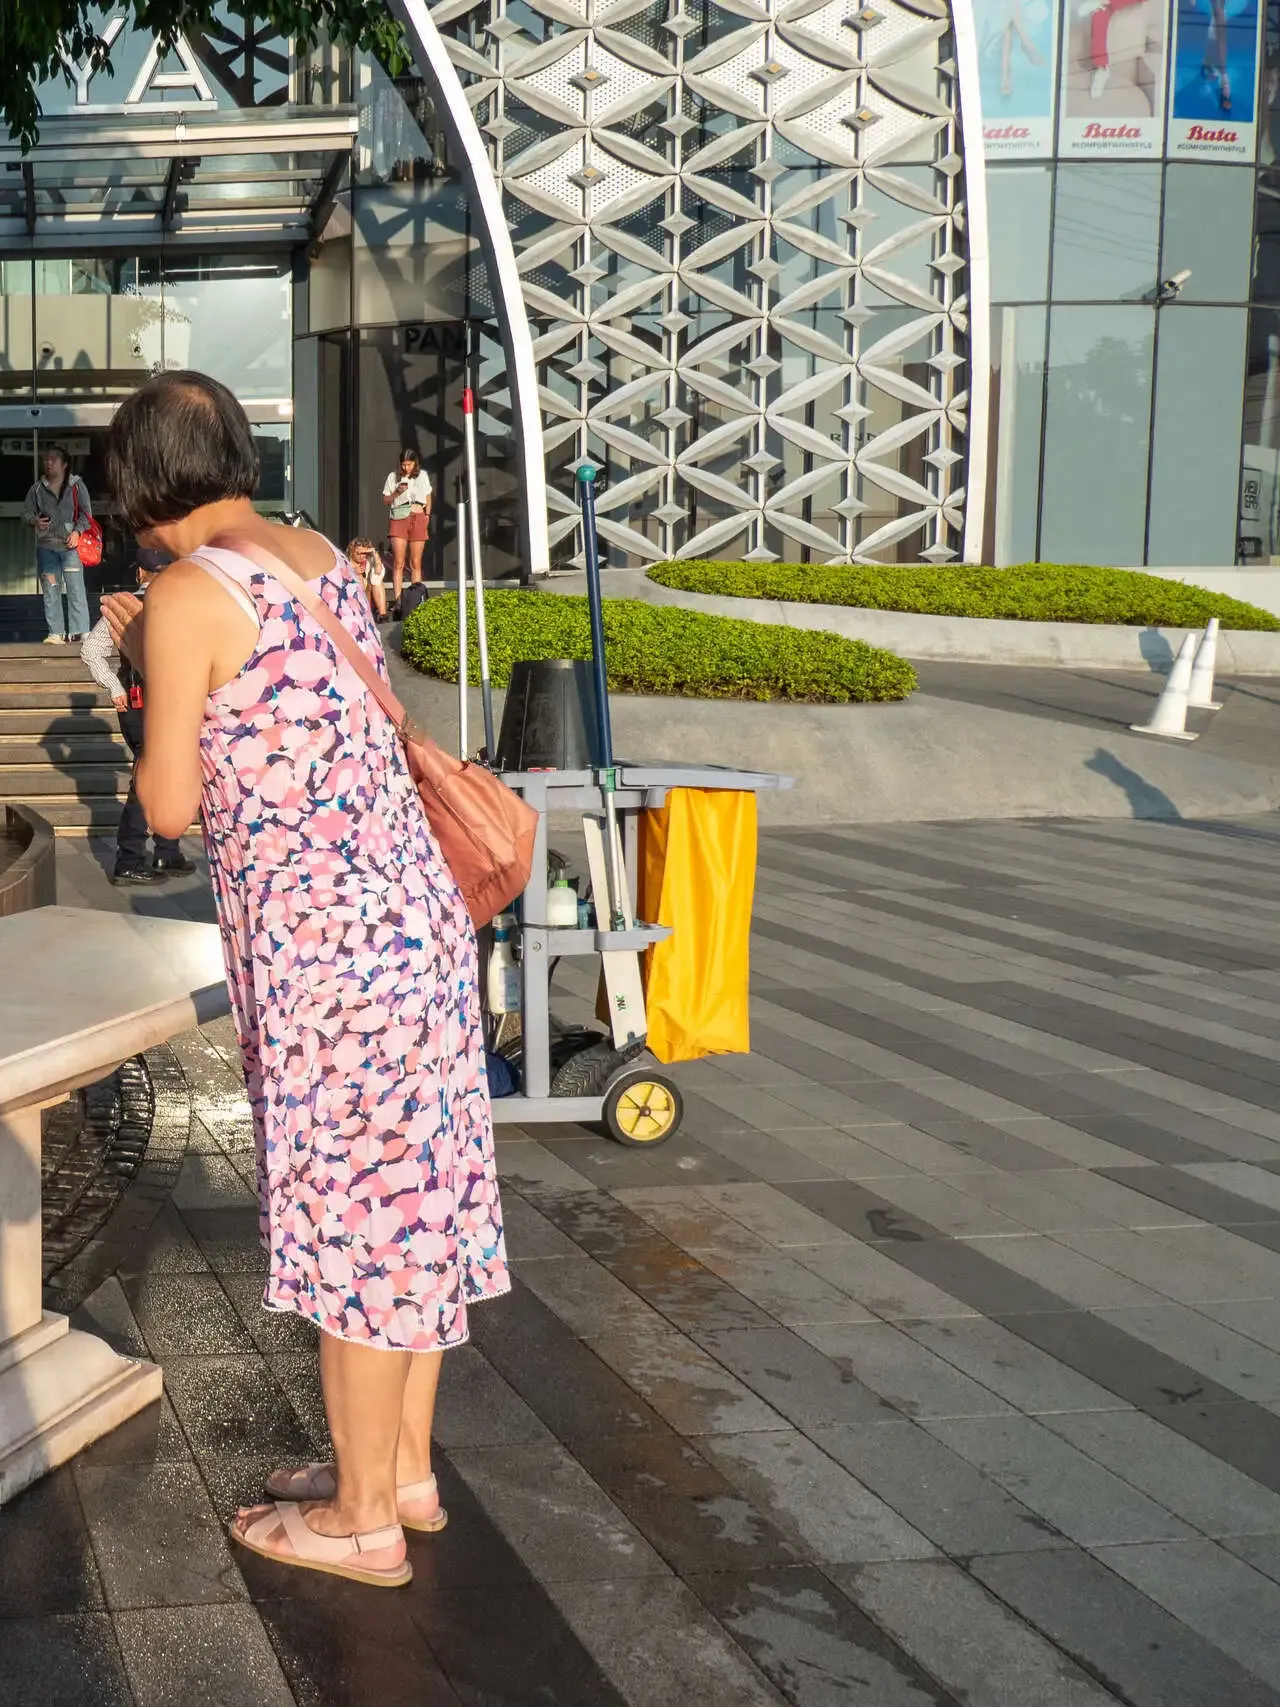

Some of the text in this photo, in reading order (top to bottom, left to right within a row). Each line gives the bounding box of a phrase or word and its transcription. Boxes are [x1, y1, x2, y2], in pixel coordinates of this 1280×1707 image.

[983, 124, 1031, 139] ata
[1082, 122, 1142, 139] Bata
[1186, 124, 1239, 142] Bata
